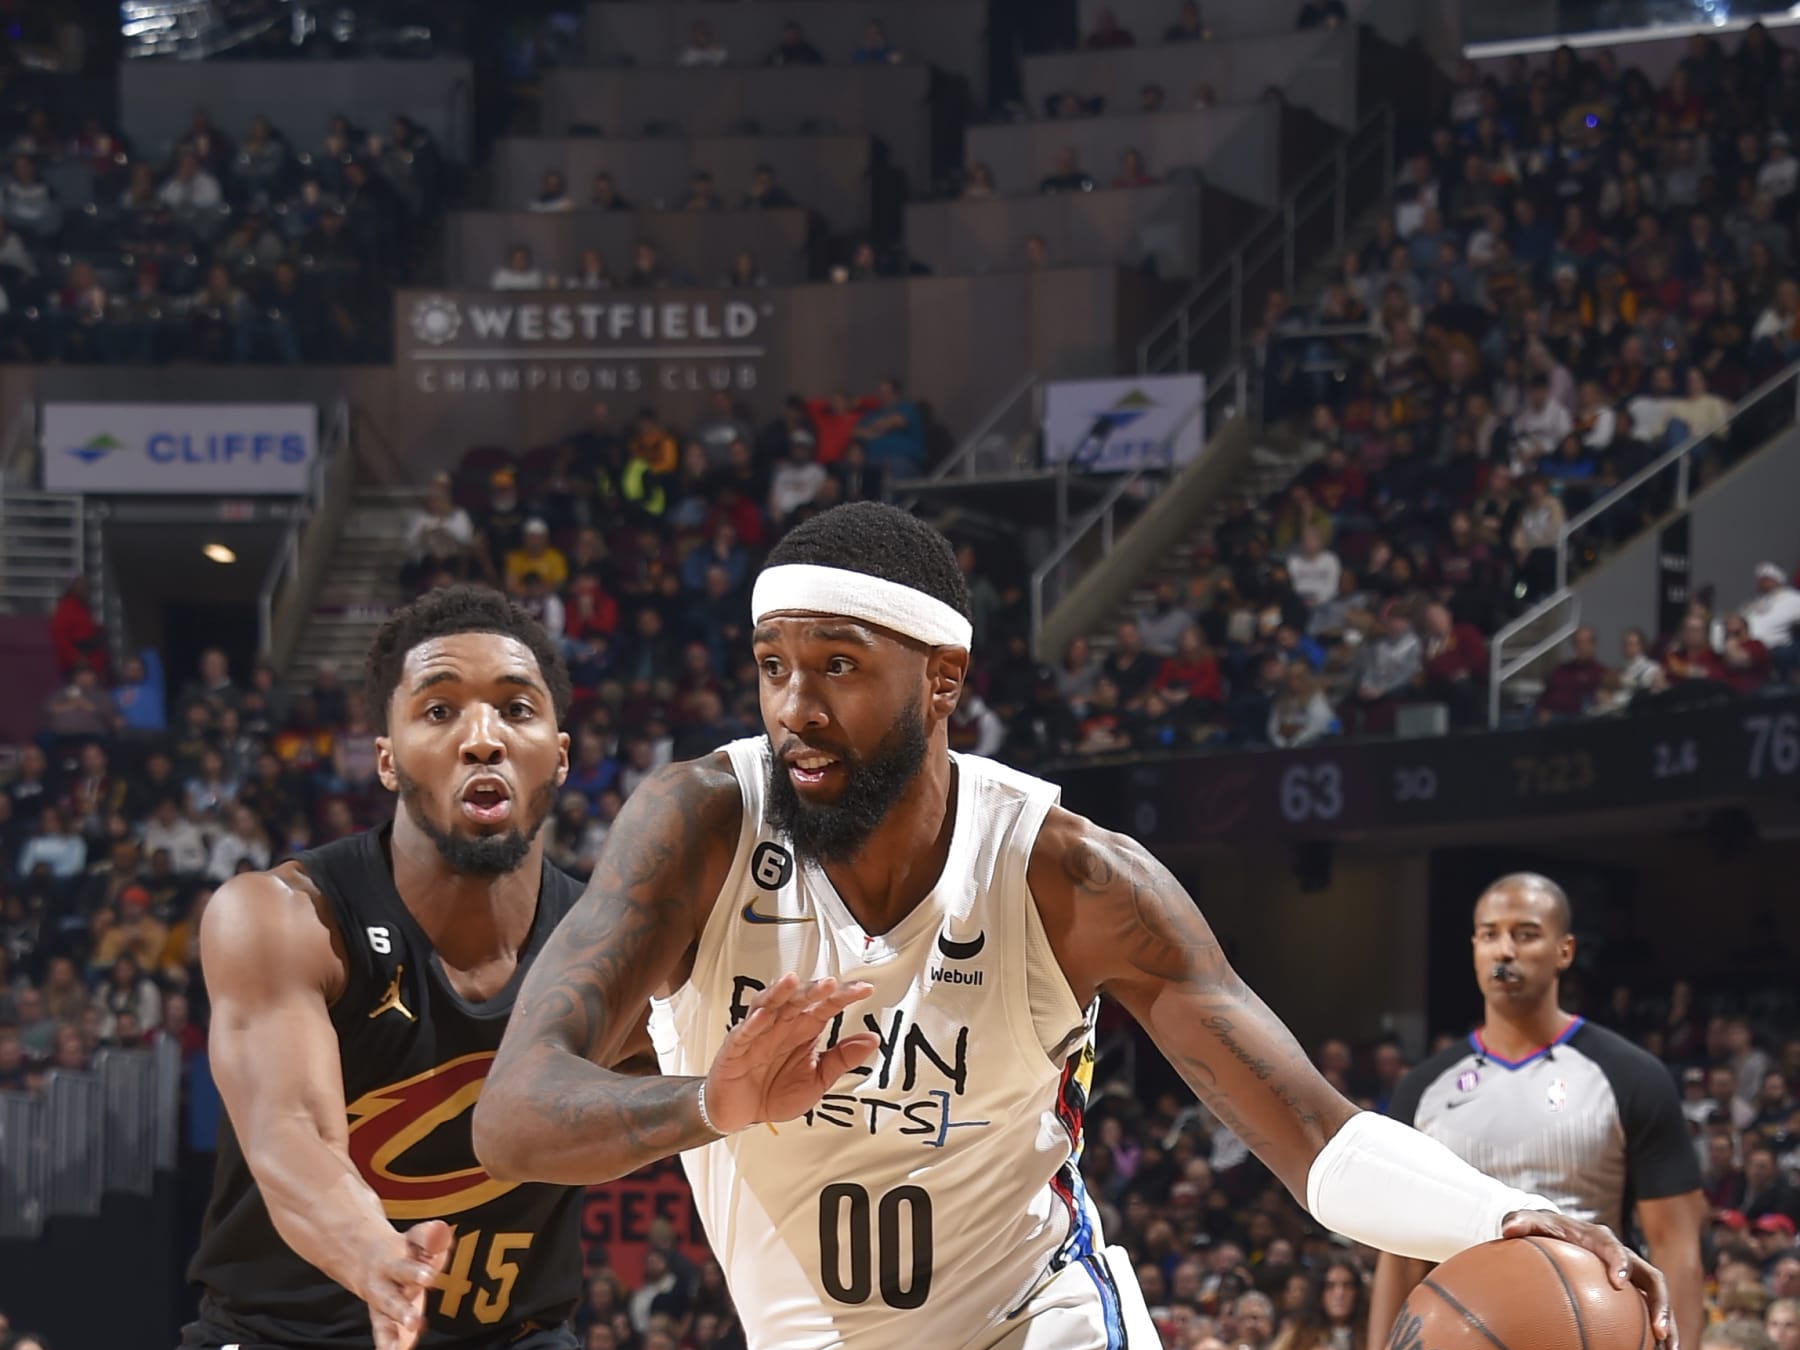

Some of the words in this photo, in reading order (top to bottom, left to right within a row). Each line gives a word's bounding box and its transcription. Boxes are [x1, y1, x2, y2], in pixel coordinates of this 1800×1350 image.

[469, 303, 758, 341] WESTFIELD
[417, 368, 642, 393] CHAMPIONS
[660, 365, 757, 391] CLUB
[146, 432, 305, 465] CLIFFS
[1744, 713, 1800, 779] 76
[1279, 762, 1344, 823] 63
[757, 849, 786, 885] 6
[366, 926, 391, 954] 6
[931, 966, 983, 985] Webull
[579, 1191, 702, 1244] GEE
[819, 1183, 934, 1310] 00
[433, 1223, 535, 1325] 45
